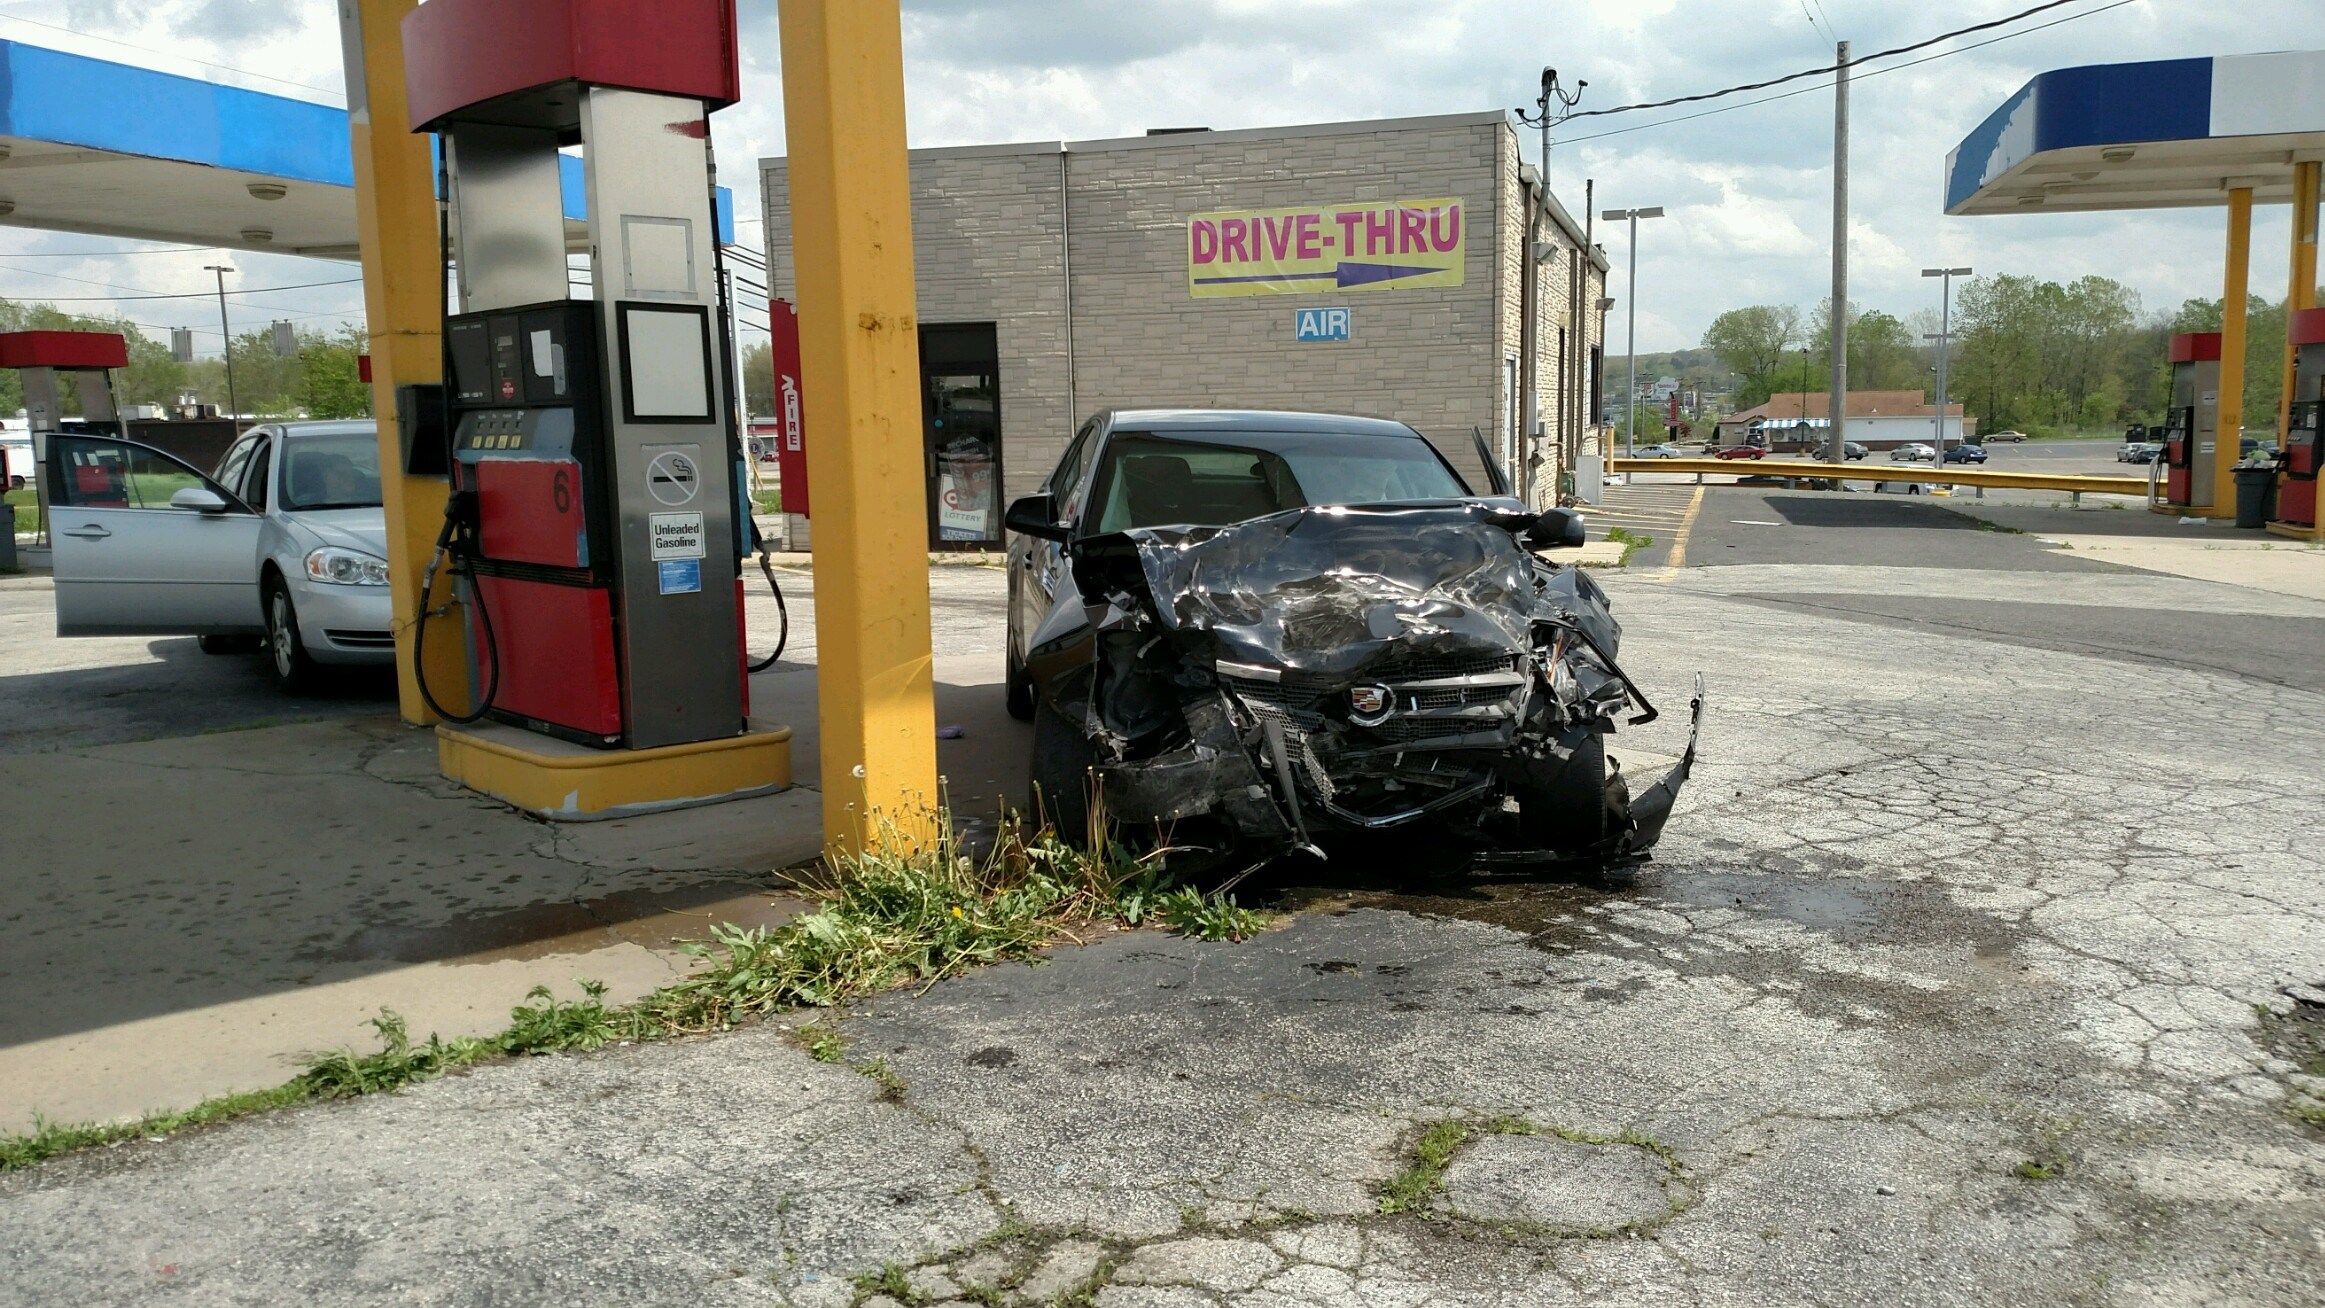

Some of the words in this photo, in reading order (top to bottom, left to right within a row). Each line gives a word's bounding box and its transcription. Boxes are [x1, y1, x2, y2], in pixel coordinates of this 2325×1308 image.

[1191, 205, 1461, 265] DRIVE-THRU
[1298, 310, 1348, 337] AIR
[787, 394, 798, 446] FIRE
[553, 469, 570, 514] 6
[654, 523, 700, 536] Unleaded
[944, 510, 982, 523] LOTTERY
[655, 536, 697, 549] Gasoline
